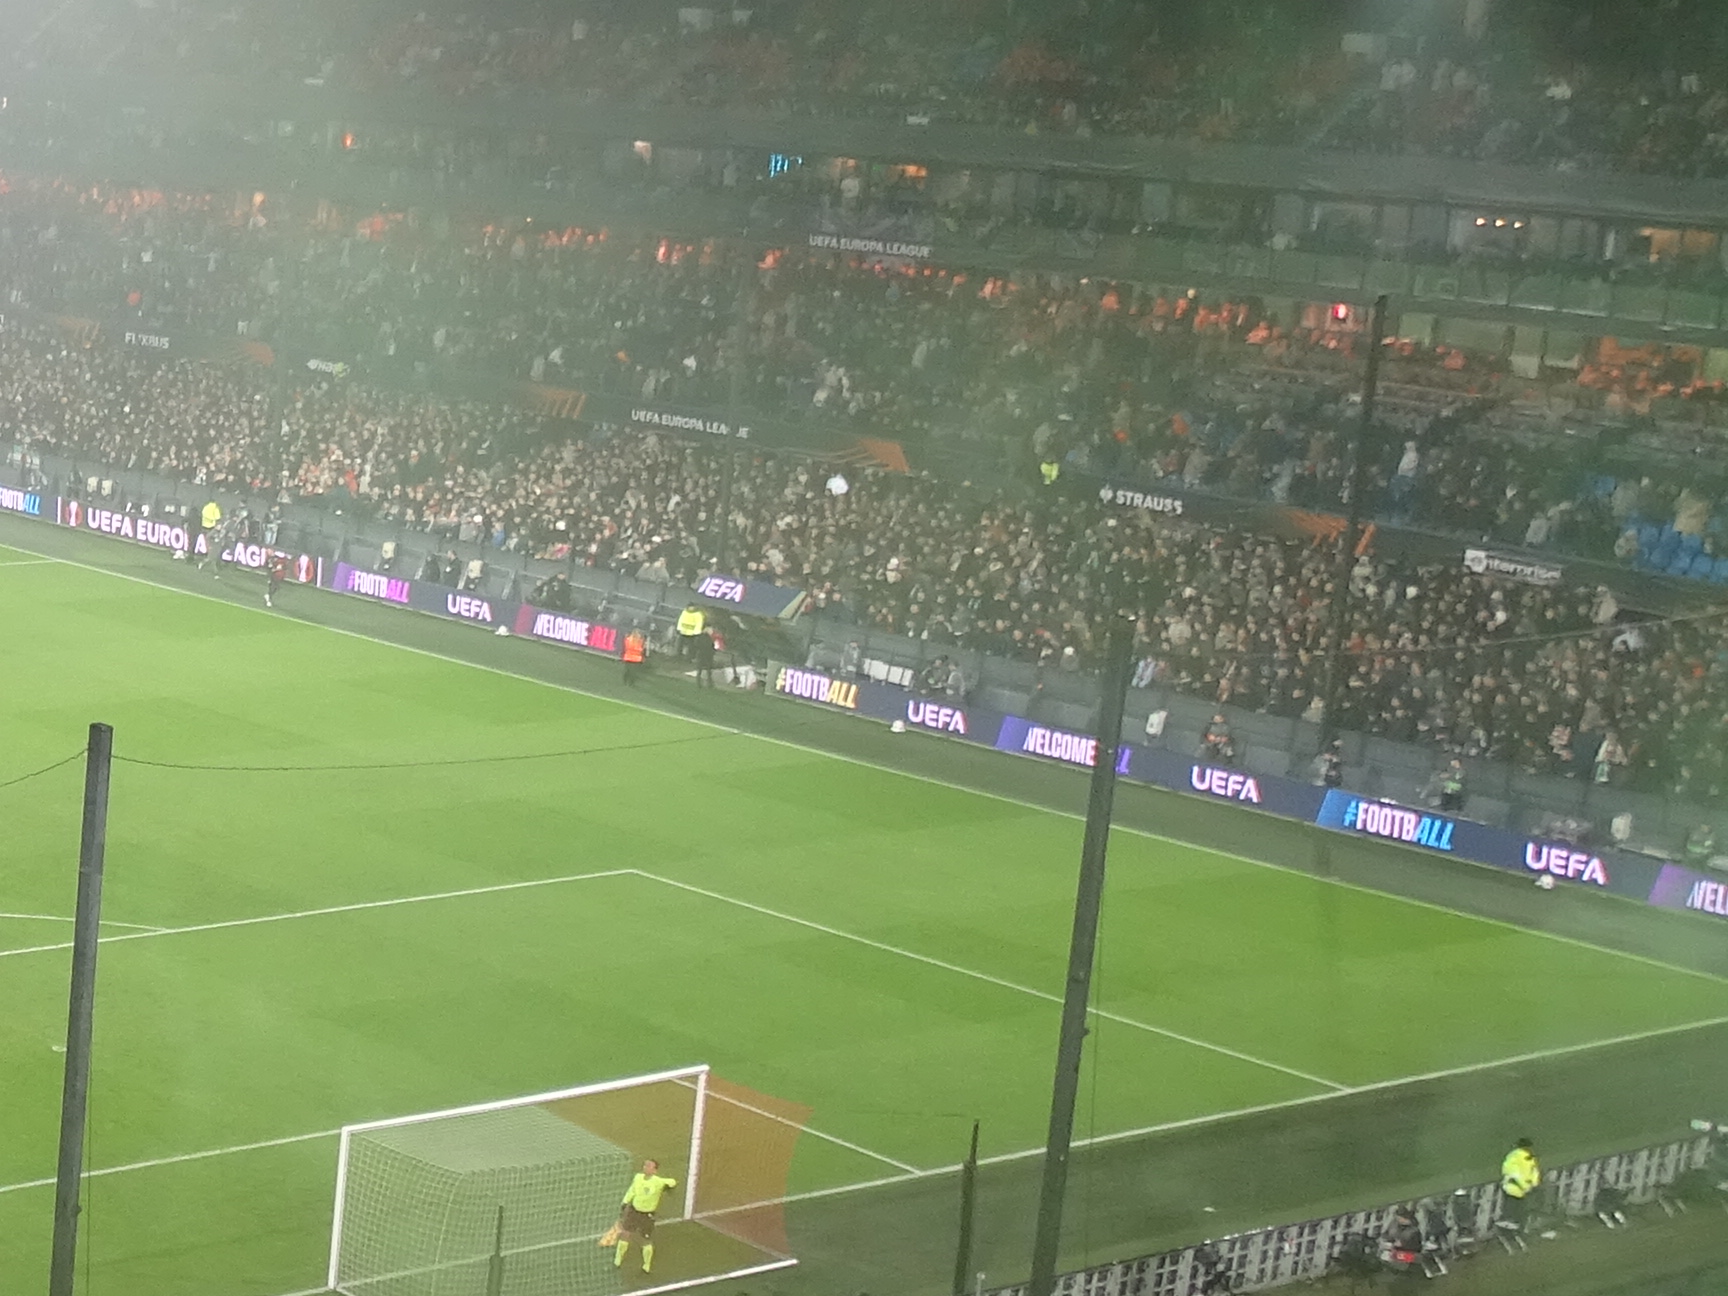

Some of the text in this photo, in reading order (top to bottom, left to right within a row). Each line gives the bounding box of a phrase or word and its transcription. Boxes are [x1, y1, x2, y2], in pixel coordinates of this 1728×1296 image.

[631, 408, 750, 440] UEFA EUROPA LEAUE
[1115, 489, 1183, 515] STRAUSS
[86, 506, 134, 538] UEFA
[136, 519, 208, 554] EUROA
[347, 569, 411, 604] #FOOTBALL
[446, 593, 492, 622] UEFA
[774, 666, 859, 710] #FOOTBALL
[905, 699, 968, 735] UEFA
[1190, 764, 1263, 804] UEFA
[1343, 799, 1455, 852] #FOOTBALL
[1524, 841, 1610, 886] UEFA
